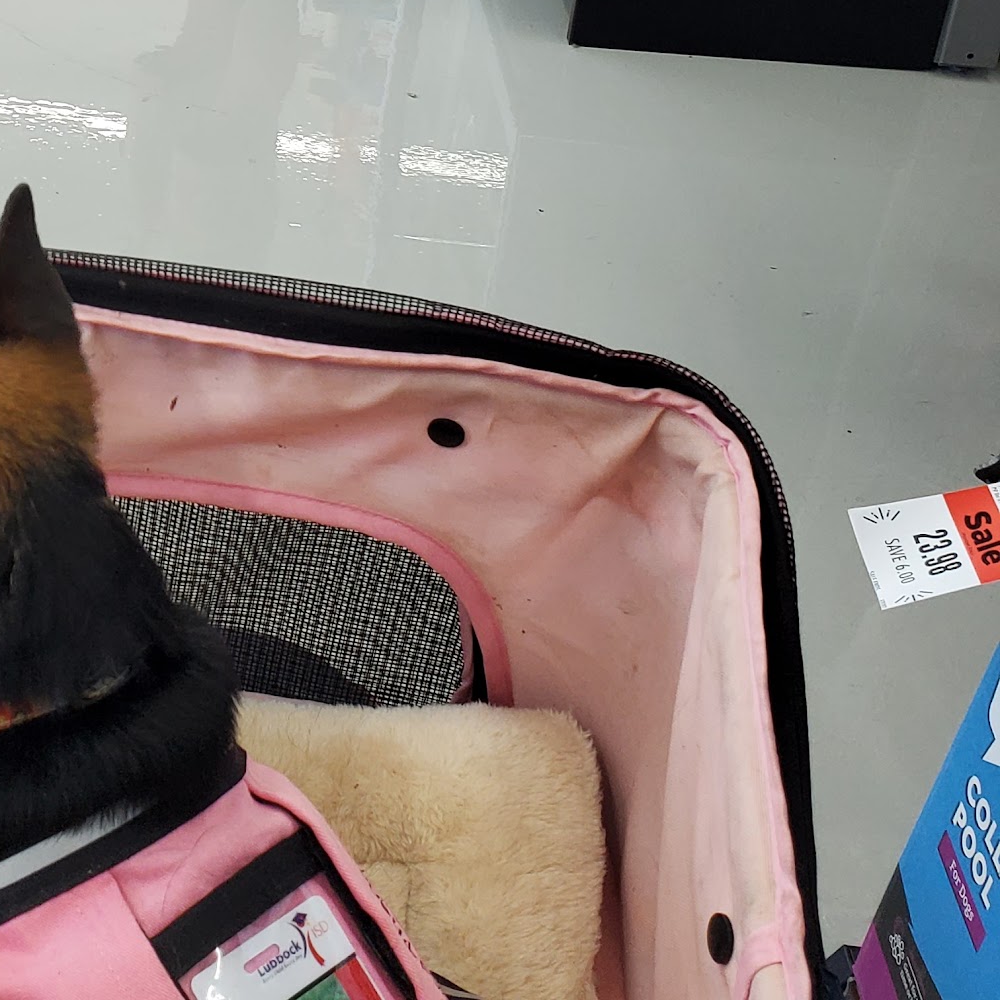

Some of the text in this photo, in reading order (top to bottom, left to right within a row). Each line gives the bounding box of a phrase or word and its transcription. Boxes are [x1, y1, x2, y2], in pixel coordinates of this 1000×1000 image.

[884, 538, 915, 584] SAVE 6.00
[912, 529, 962, 576] 23.98
[964, 511, 1000, 566] Sale
[952, 801, 994, 910] POOL
[949, 859, 974, 921] For Dogs
[257, 940, 302, 977] Lubbock
[311, 920, 329, 938] ISD
